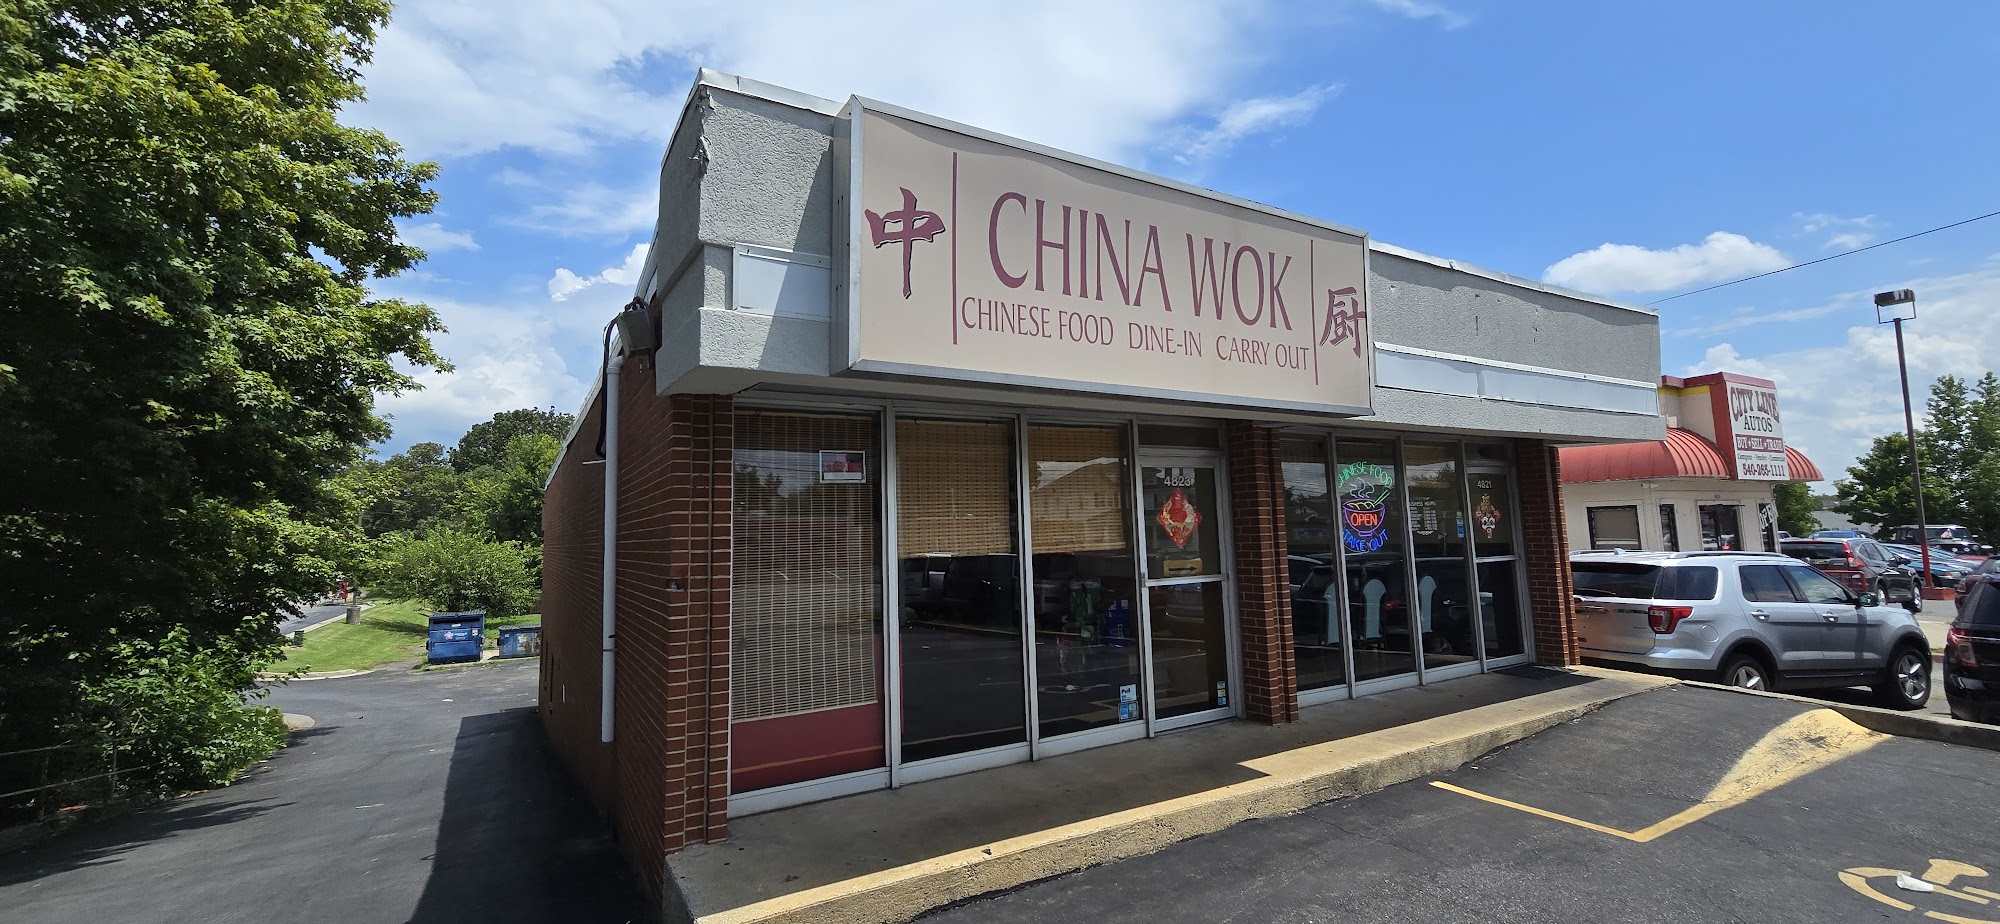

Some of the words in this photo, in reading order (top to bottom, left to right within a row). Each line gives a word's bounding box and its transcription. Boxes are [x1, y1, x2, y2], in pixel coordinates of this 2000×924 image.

[864, 186, 946, 300] 中
[988, 191, 1173, 312] CHINA
[1186, 232, 1293, 331] WOK
[961, 296, 1052, 339] CHINESE
[1058, 310, 1114, 346] FOOD
[1128, 322, 1202, 358] DINE-IN
[1216, 335, 1270, 366] CARRY
[1275, 343, 1310, 370] OUT
[1319, 286, 1367, 359] 厨
[1730, 386, 1753, 422] CITY
[1755, 390, 1780, 424] LINE
[1744, 414, 1773, 433] AUTOS
[1736, 436, 1748, 449] BUY
[1751, 437, 1764, 450] SELL
[1163, 475, 1191, 487] 4823
[1369, 464, 1393, 490] FOOD
[1742, 463, 1786, 477] 540-265-1111
[1351, 513, 1378, 527] OPEN
[1343, 529, 1366, 552] TAKE
[1369, 529, 1389, 551] OUT
